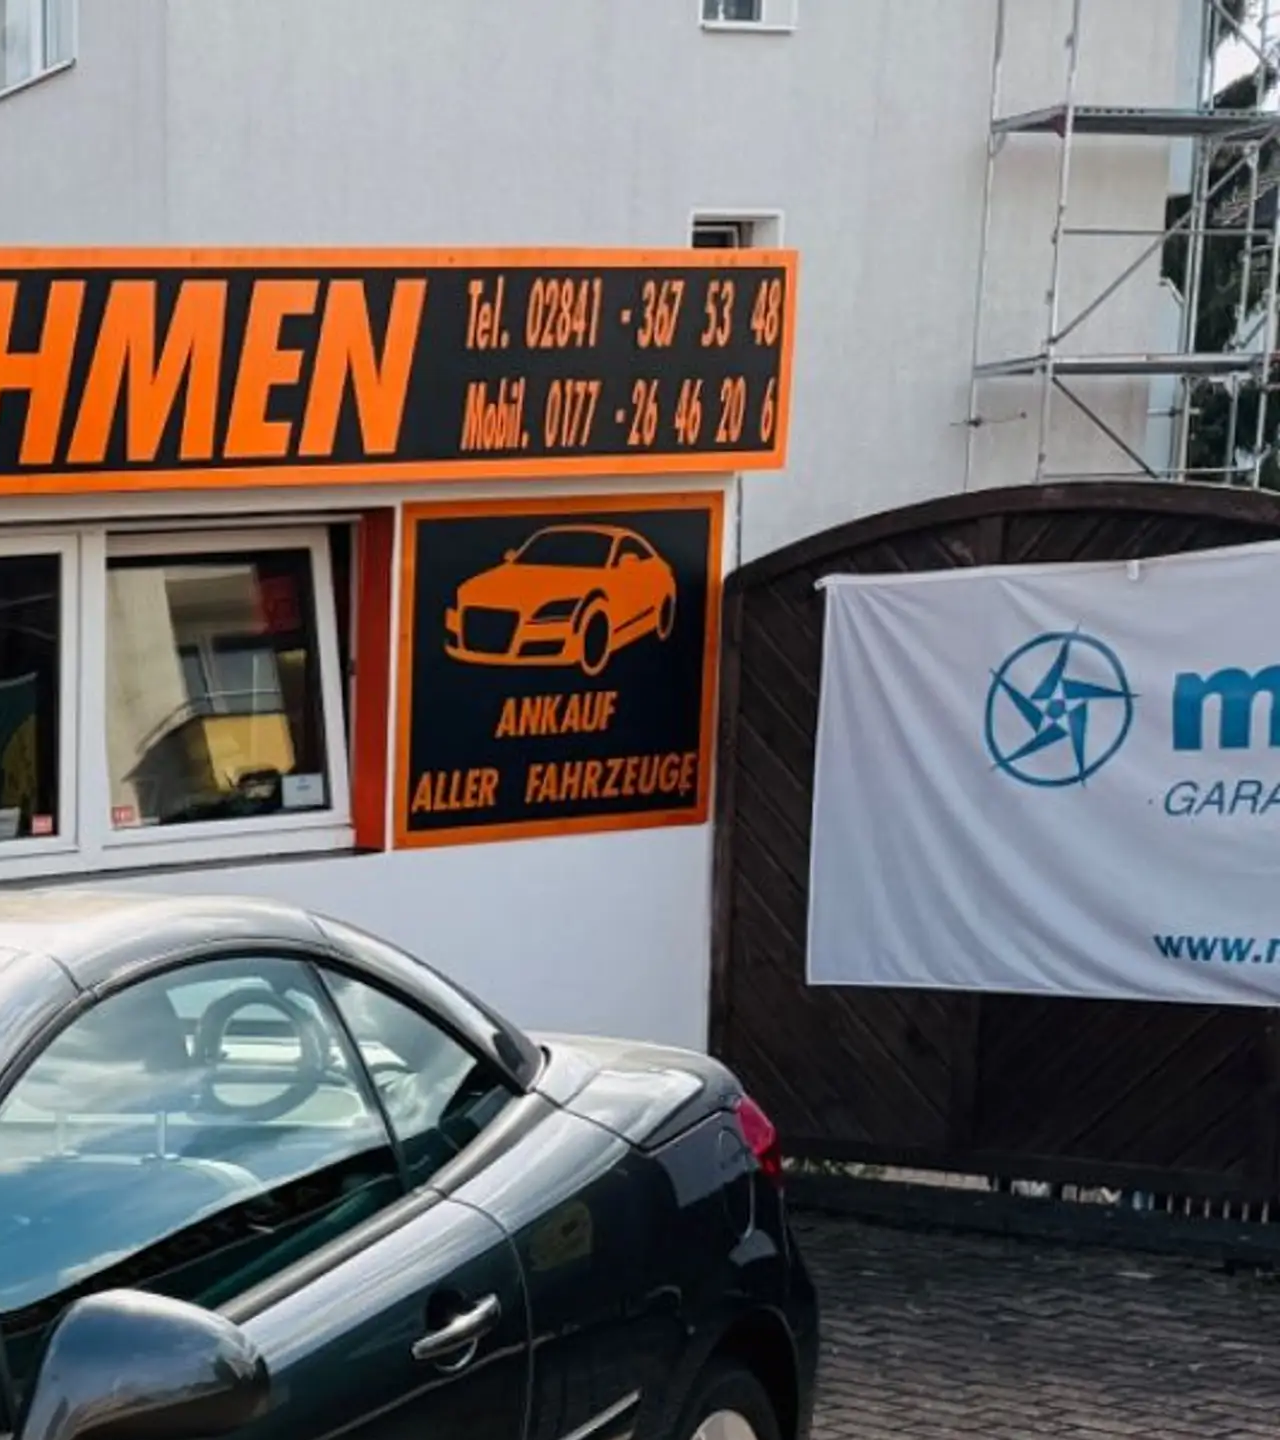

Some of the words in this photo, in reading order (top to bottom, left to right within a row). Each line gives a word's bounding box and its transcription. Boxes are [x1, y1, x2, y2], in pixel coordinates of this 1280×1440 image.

[466, 275, 509, 349] Tel.
[526, 277, 602, 348] 02841
[702, 281, 735, 347] 53
[751, 278, 781, 347] 48
[461, 378, 528, 450] Mobil.
[545, 380, 600, 447] 0177
[675, 378, 702, 444] 46
[716, 377, 746, 442] 20
[760, 378, 775, 443] 6
[495, 690, 618, 739] ANKAUF
[411, 767, 500, 814] ALLER
[524, 752, 698, 805] FAHRZEUGE
